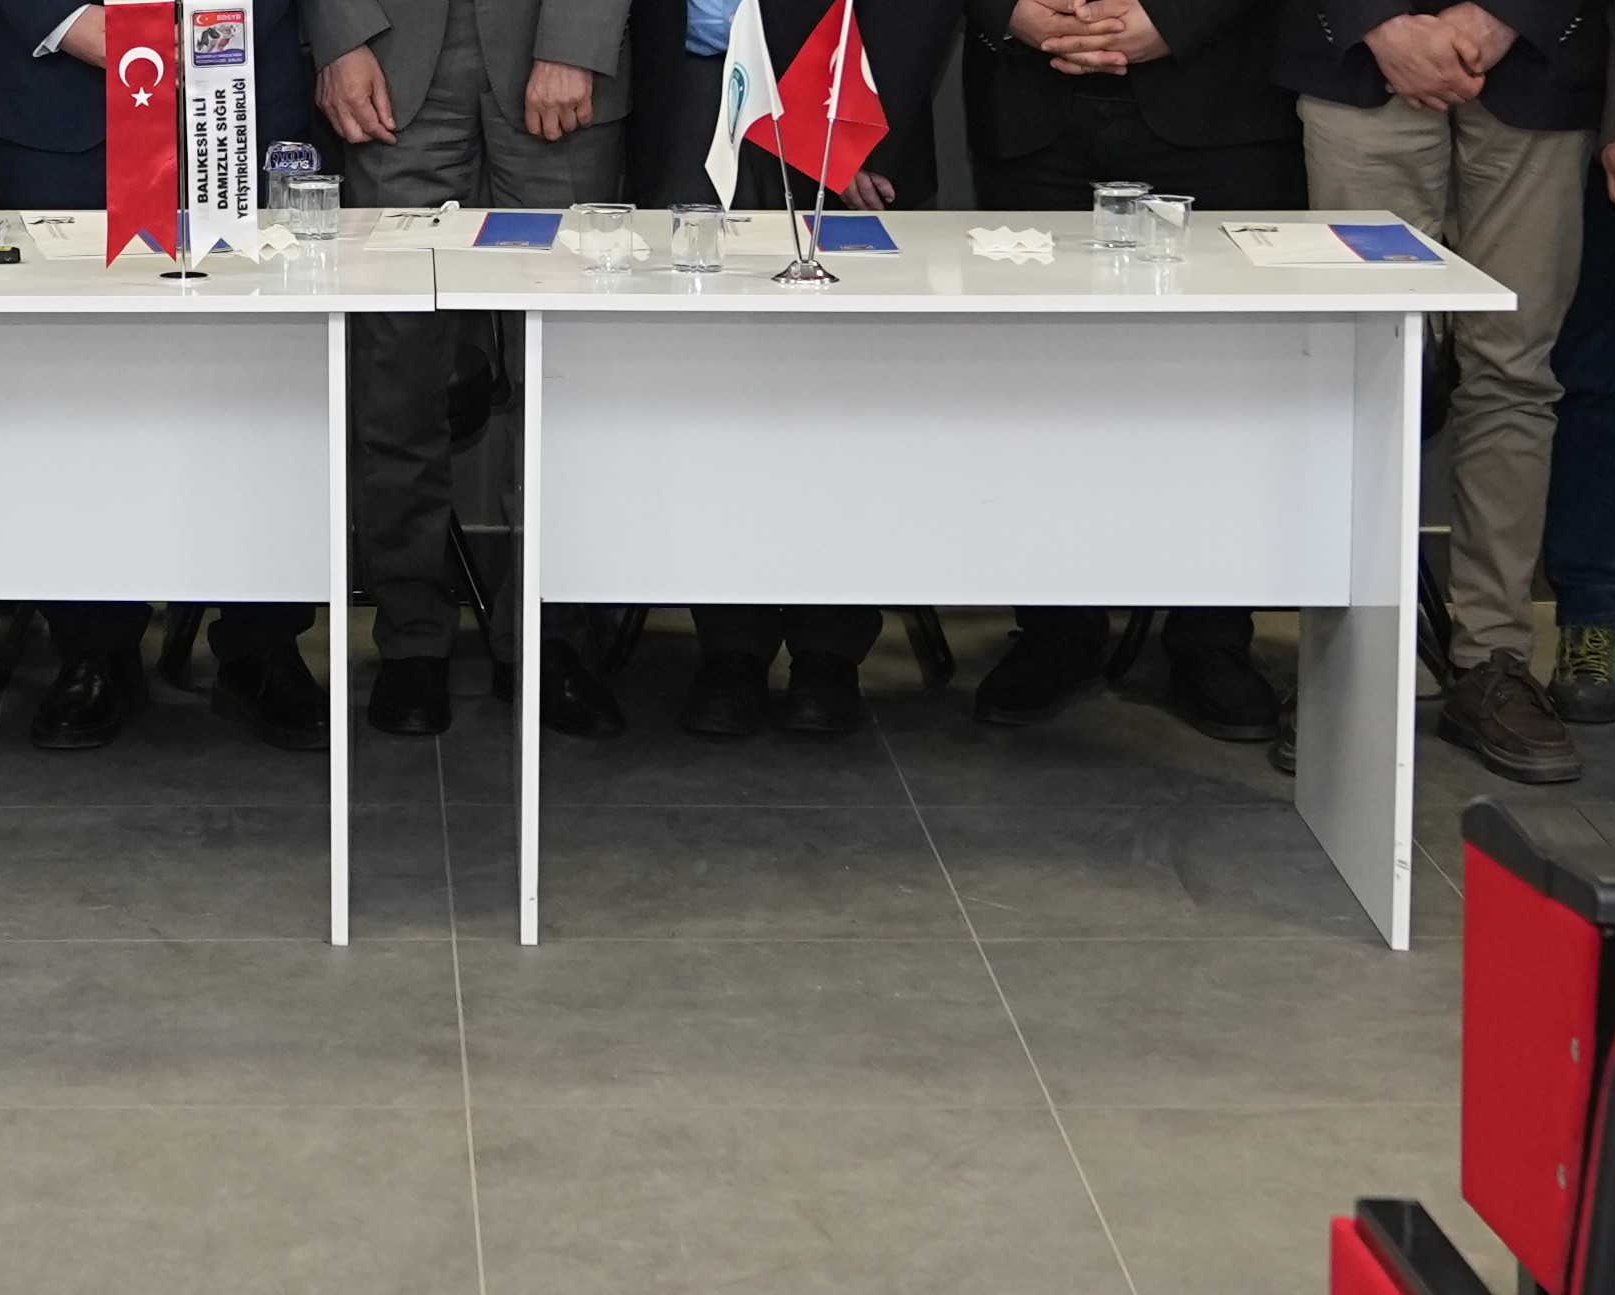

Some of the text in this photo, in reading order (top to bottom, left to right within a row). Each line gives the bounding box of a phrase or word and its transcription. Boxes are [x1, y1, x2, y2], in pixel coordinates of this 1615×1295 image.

[192, 97, 209, 204] BALIKESİR İLİ
[213, 88, 229, 210] DAMIZLIK SIĞIR
[232, 78, 247, 122] BİRLİĞİ
